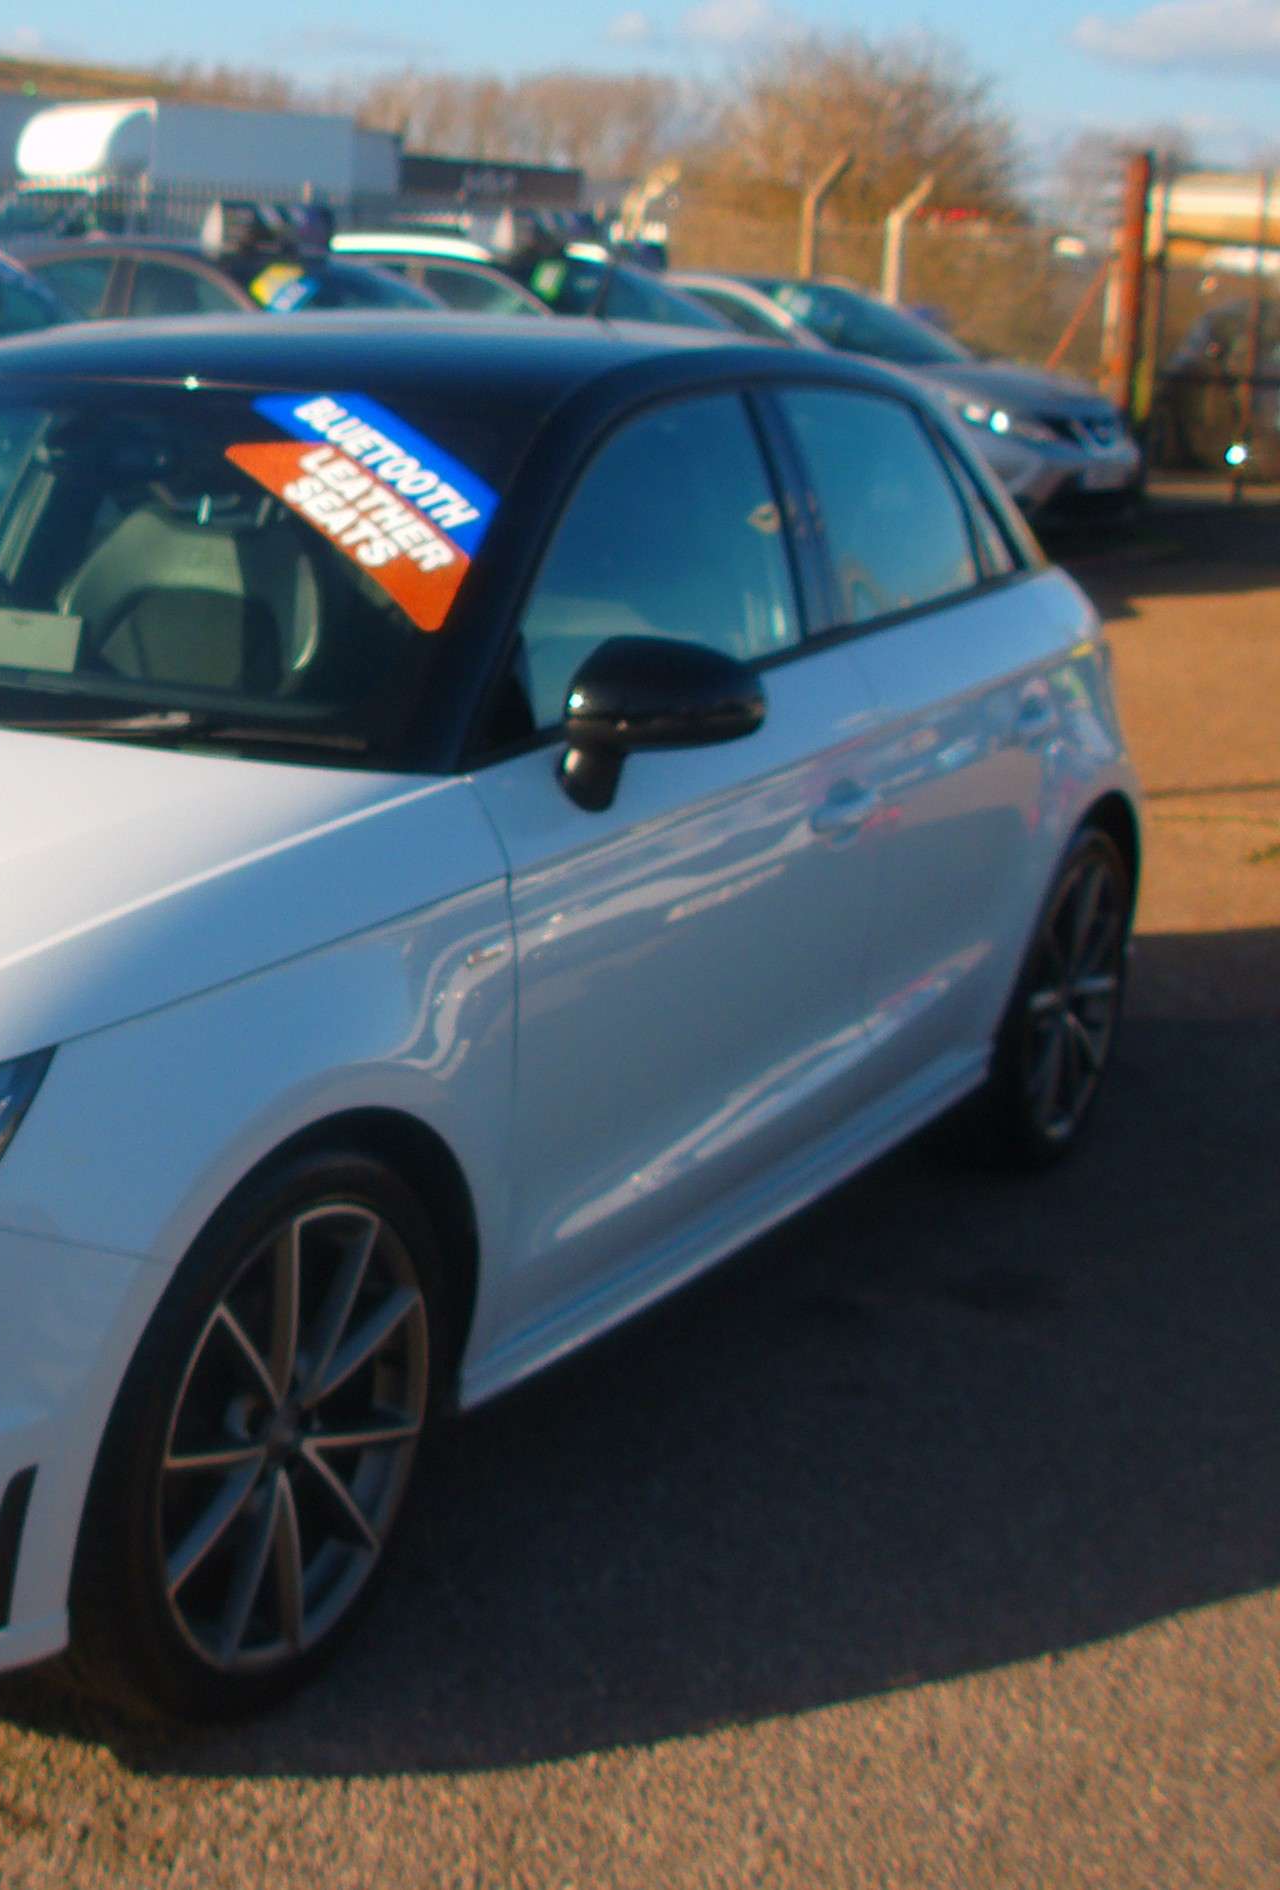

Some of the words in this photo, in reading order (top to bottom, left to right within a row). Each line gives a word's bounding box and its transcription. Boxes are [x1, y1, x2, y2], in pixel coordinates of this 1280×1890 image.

[282, 474, 401, 568] SEATS
[293, 395, 481, 529] BLUETOOTH
[297, 445, 456, 572] LEATHER
